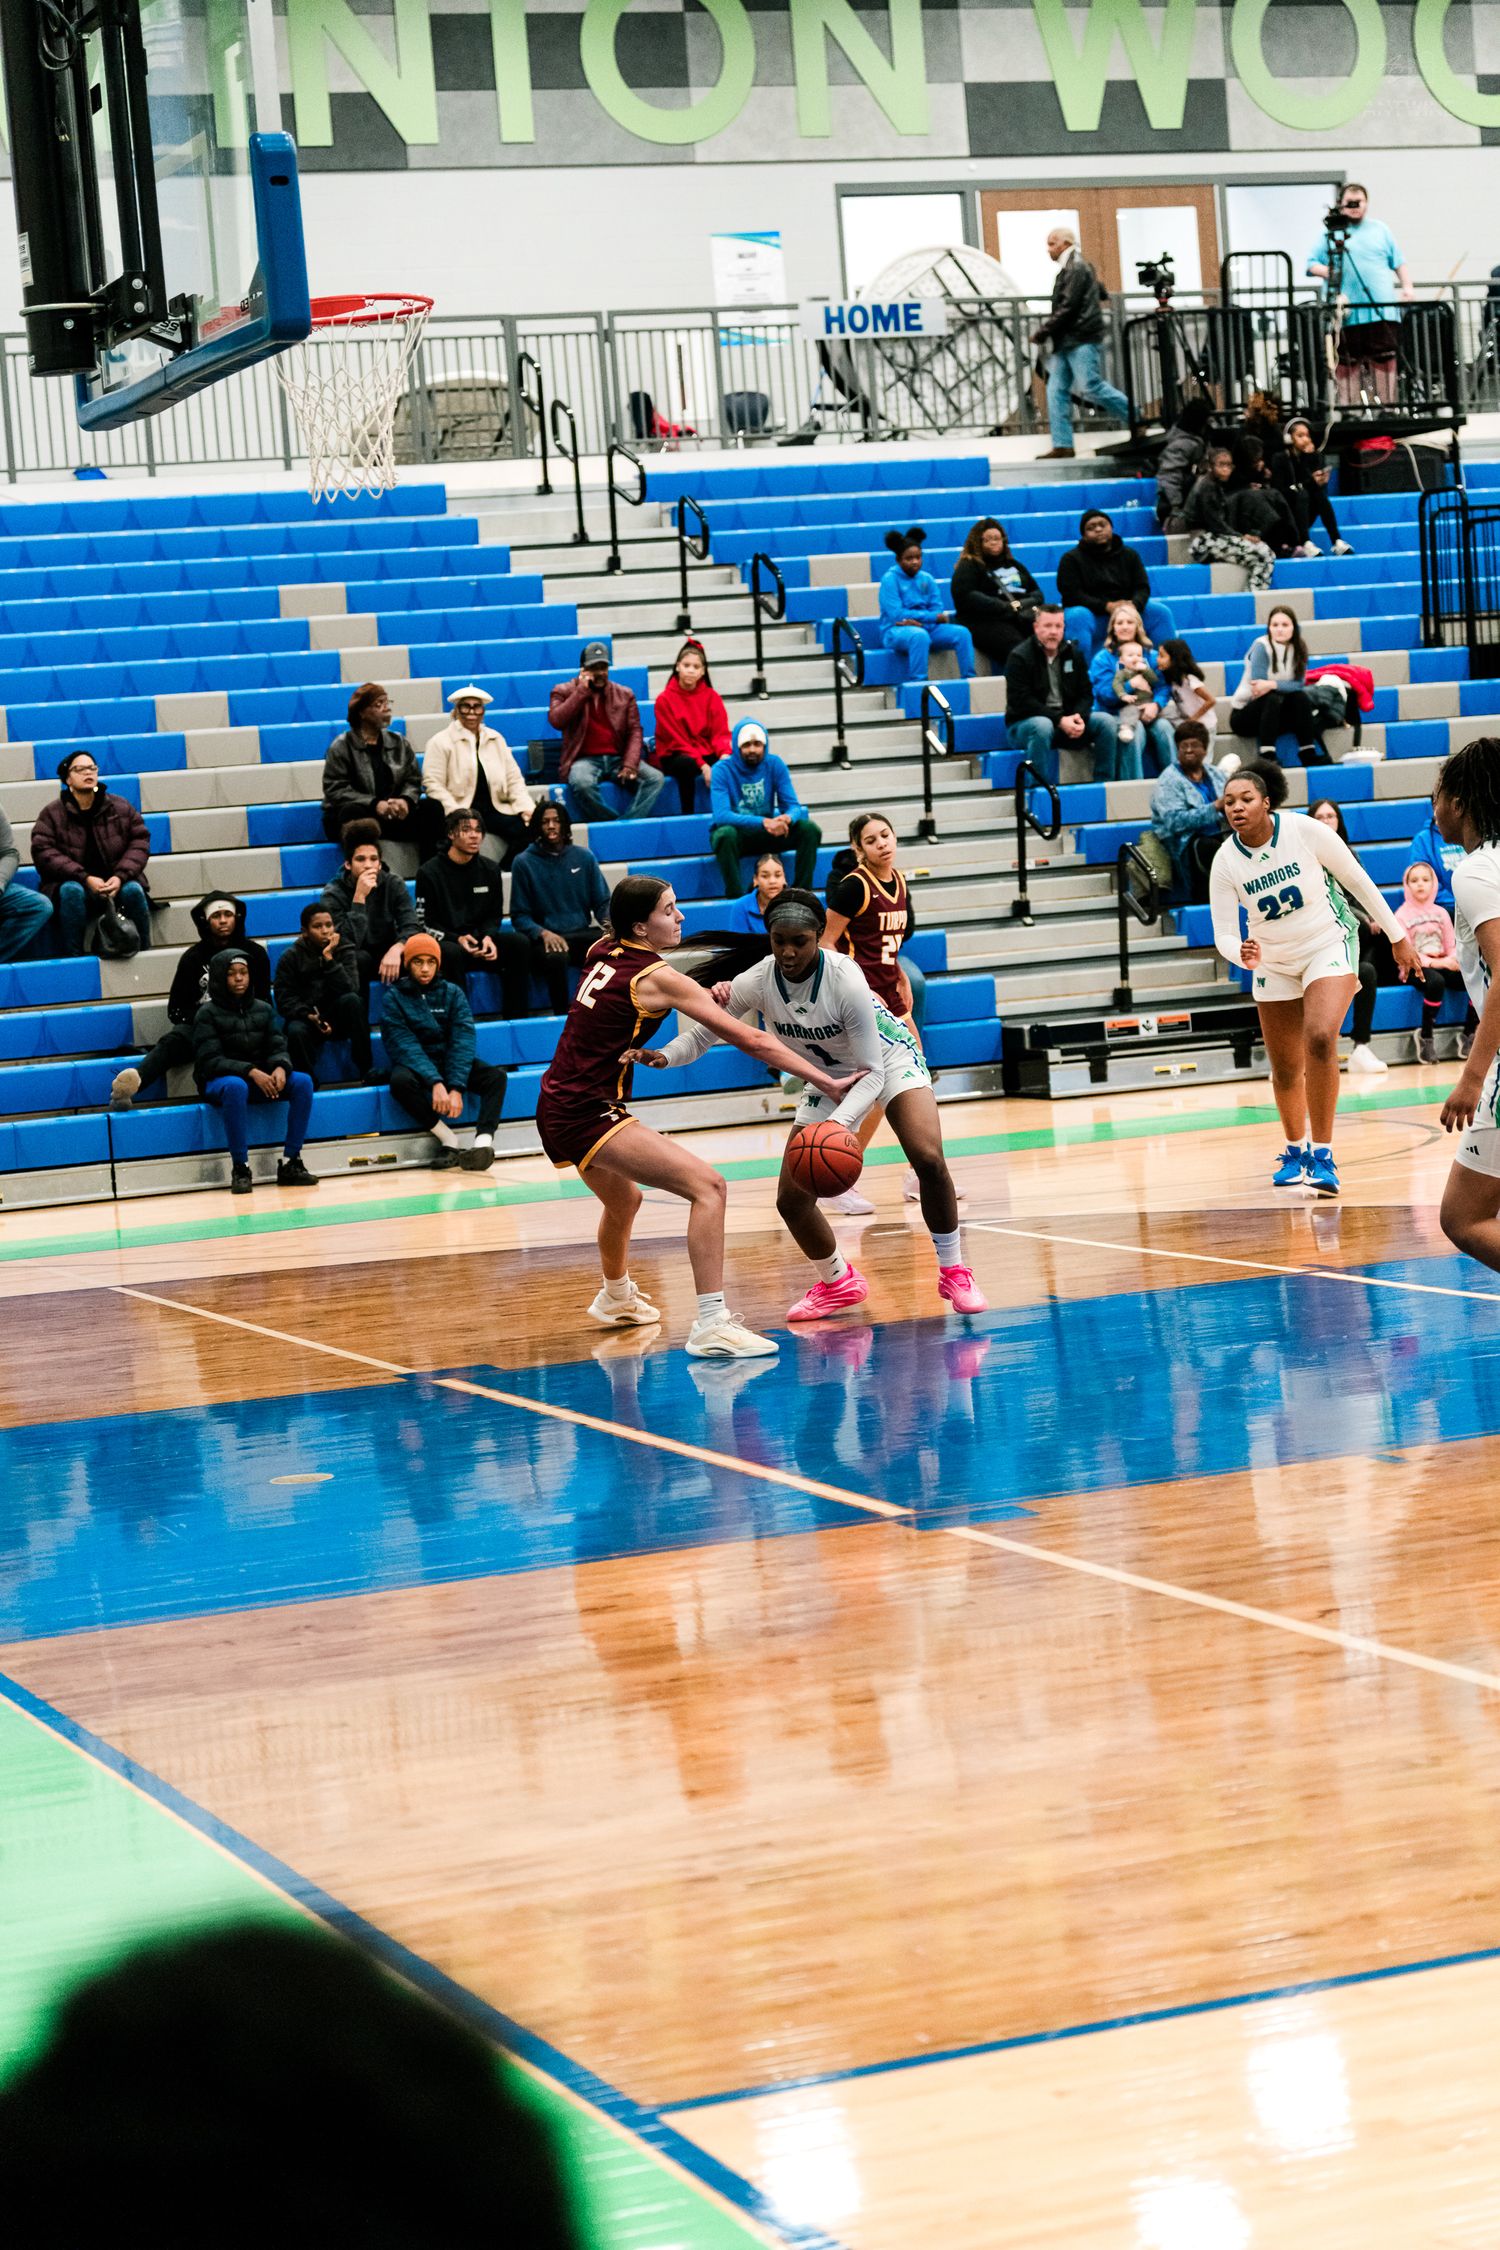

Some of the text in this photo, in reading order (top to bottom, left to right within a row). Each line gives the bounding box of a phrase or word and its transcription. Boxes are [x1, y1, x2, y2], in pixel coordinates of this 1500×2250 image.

[824, 303, 923, 334] HOME
[1243, 862, 1301, 895] WARRIORS
[1257, 885, 1304, 921] 23
[576, 961, 617, 1010] 12
